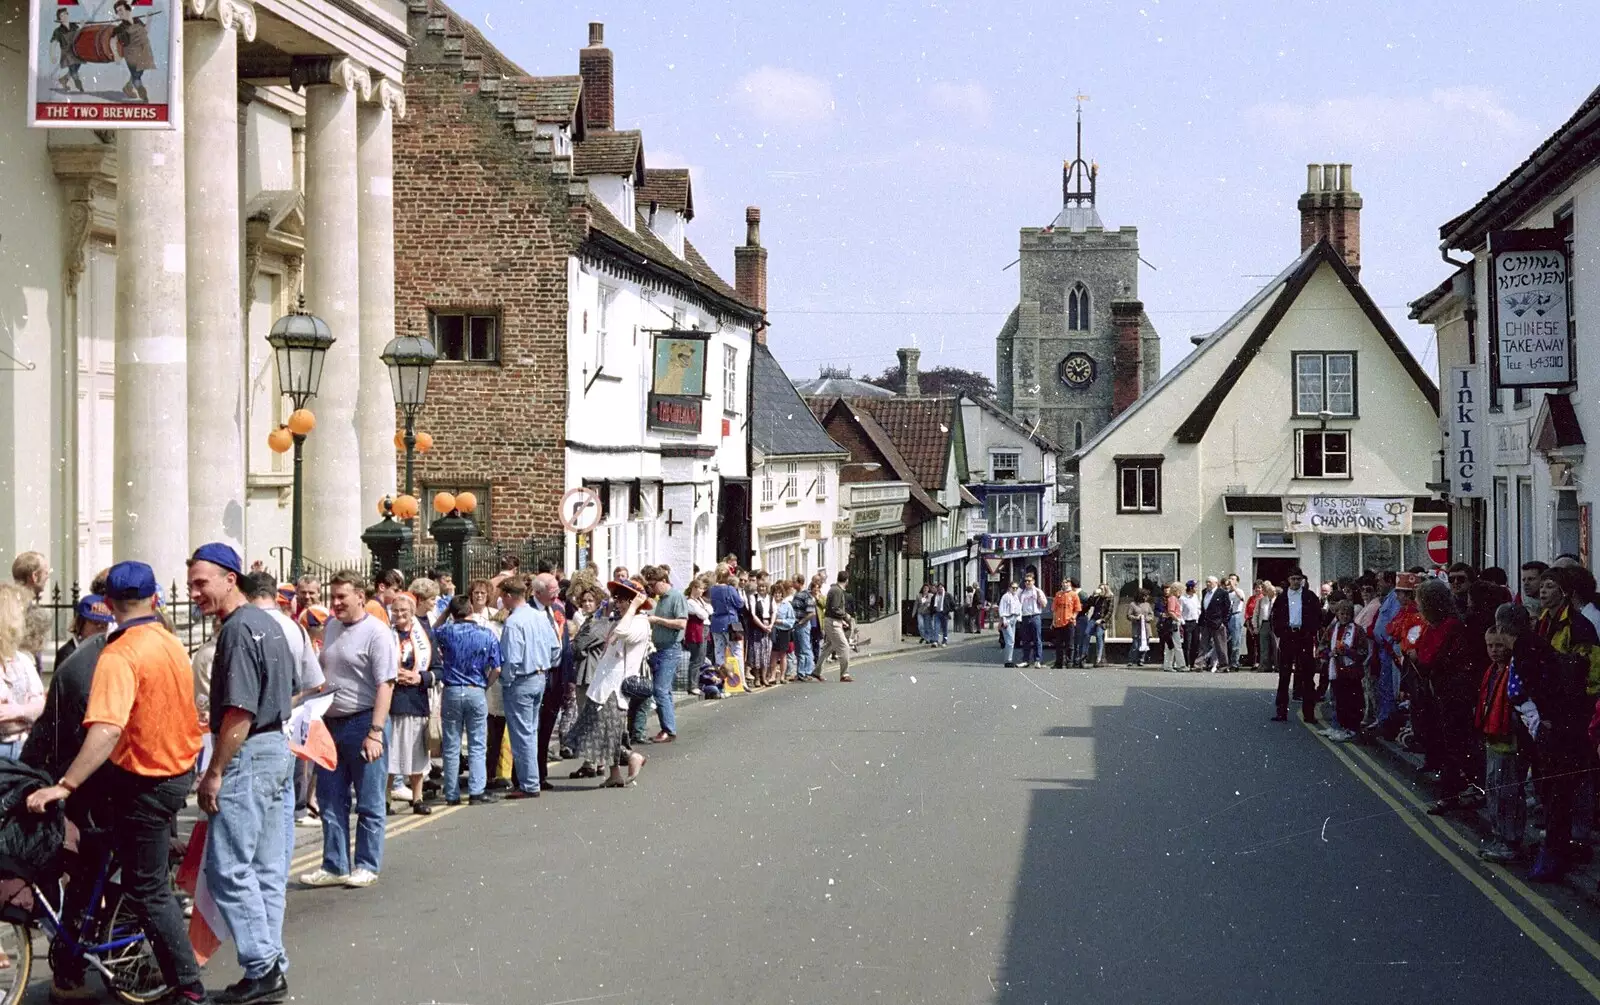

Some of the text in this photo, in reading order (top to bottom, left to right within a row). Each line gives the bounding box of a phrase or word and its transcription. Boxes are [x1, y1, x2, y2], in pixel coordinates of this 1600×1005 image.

[46, 106, 157, 119] THE TWO BREWERS
[1503, 256, 1560, 272] CHINA
[1498, 271, 1565, 289] KITCHEN
[1505, 321, 1560, 337] CHINESE
[1502, 338, 1565, 354] TAKE-AWAY
[1457, 370, 1476, 479] Ink Inc
[1313, 497, 1367, 508] DISS TOWN
[1311, 514, 1385, 530] CHAMPIONS
